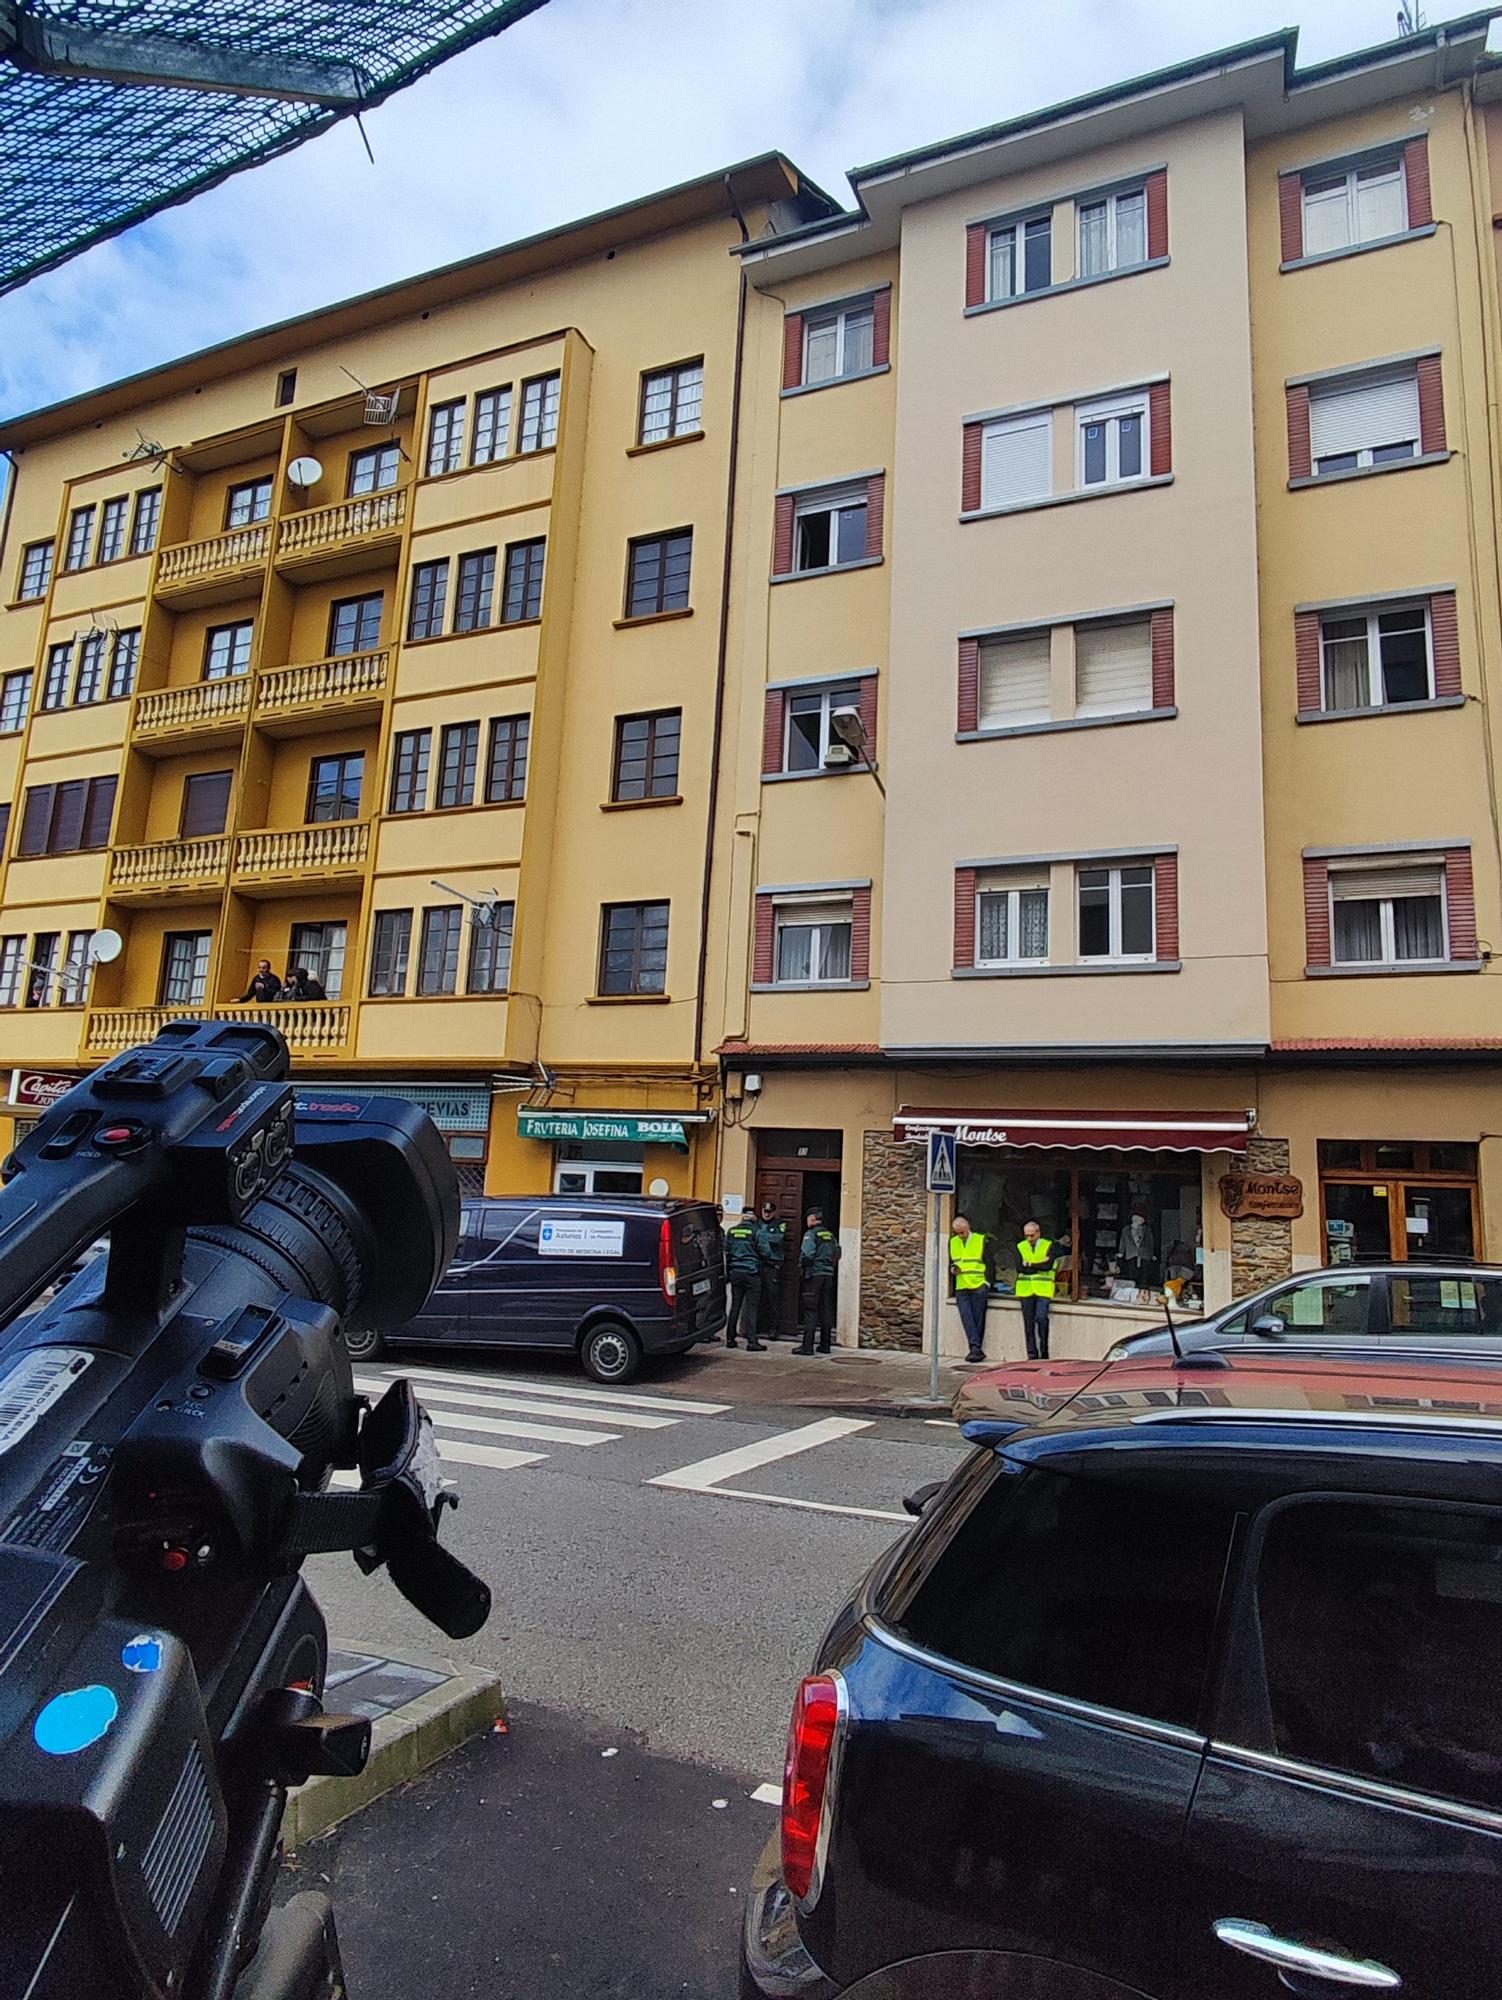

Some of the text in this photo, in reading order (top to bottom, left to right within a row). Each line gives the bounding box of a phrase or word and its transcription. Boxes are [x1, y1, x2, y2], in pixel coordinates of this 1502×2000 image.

[582, 1119, 629, 1139] JOSEFINA
[955, 1124, 1008, 1142] Montse
[556, 1232, 582, 1240] Asturias
